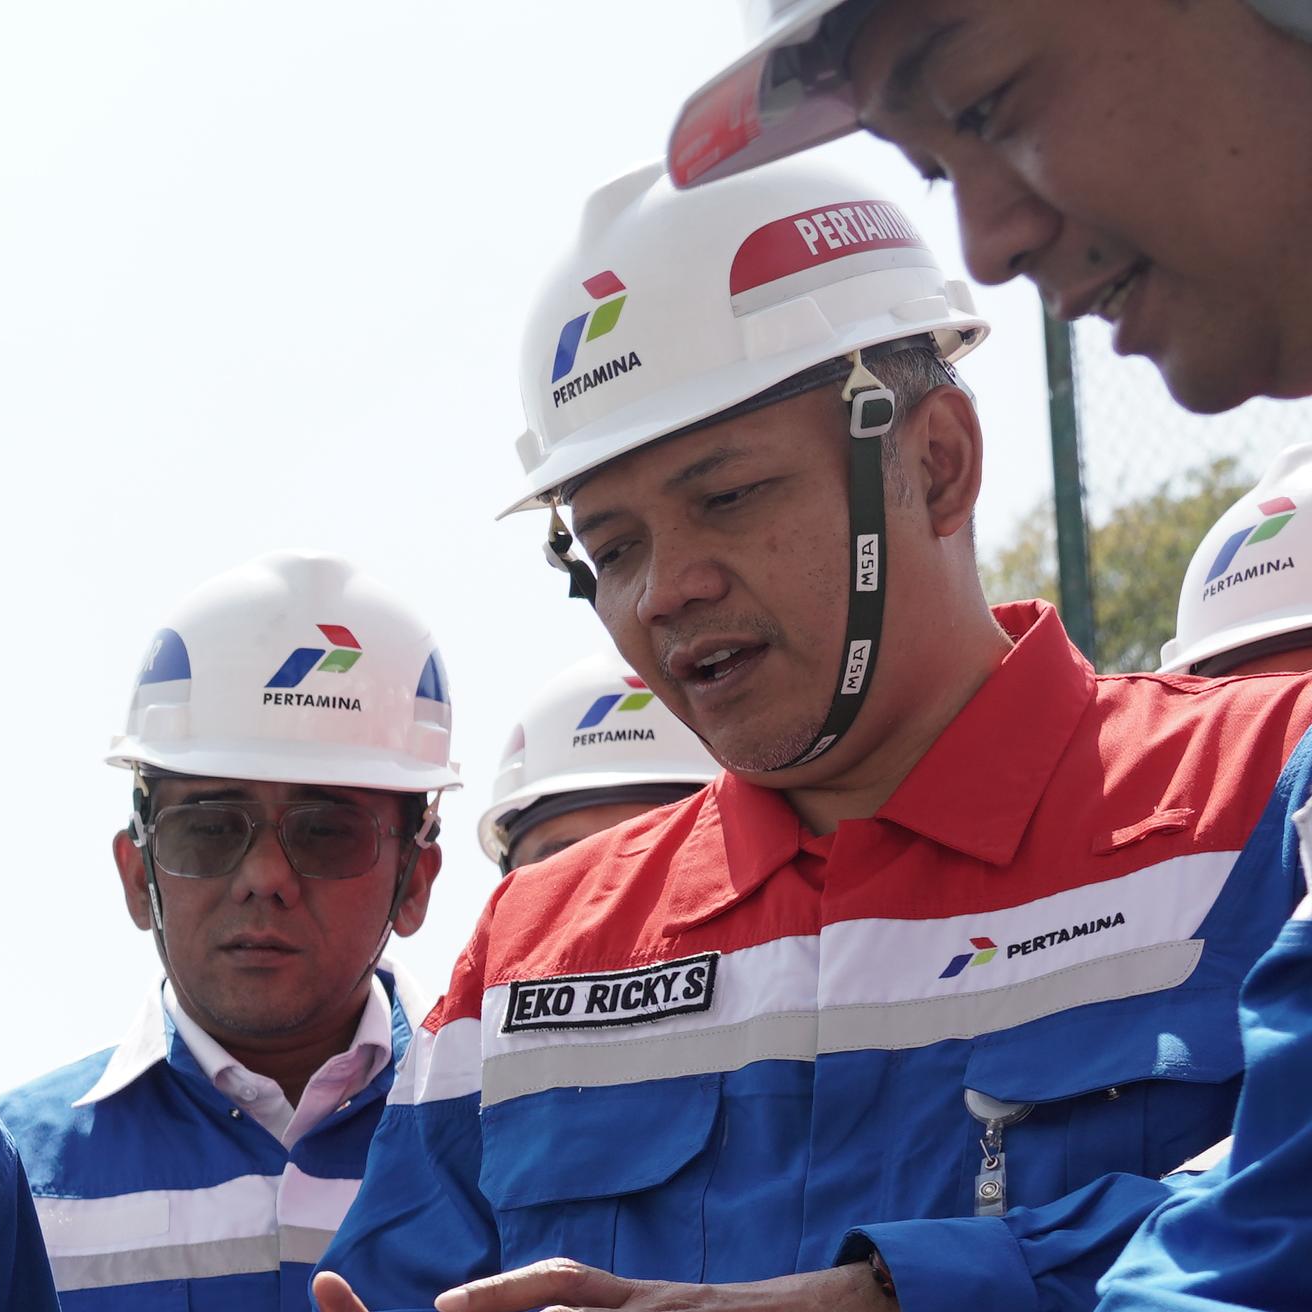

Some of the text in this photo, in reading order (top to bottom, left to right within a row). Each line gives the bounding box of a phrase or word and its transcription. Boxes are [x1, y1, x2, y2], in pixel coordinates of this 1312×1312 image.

[552, 351, 642, 408] PERTAMINA
[861, 539, 874, 586] MSA
[1202, 556, 1295, 602] PERTAMINA
[846, 645, 866, 690] MSA
[263, 692, 362, 712] PERTAMINA
[572, 728, 655, 748] PERTAMINA
[1007, 911, 1125, 959] PERTAMINA
[514, 985, 575, 1021] EKO
